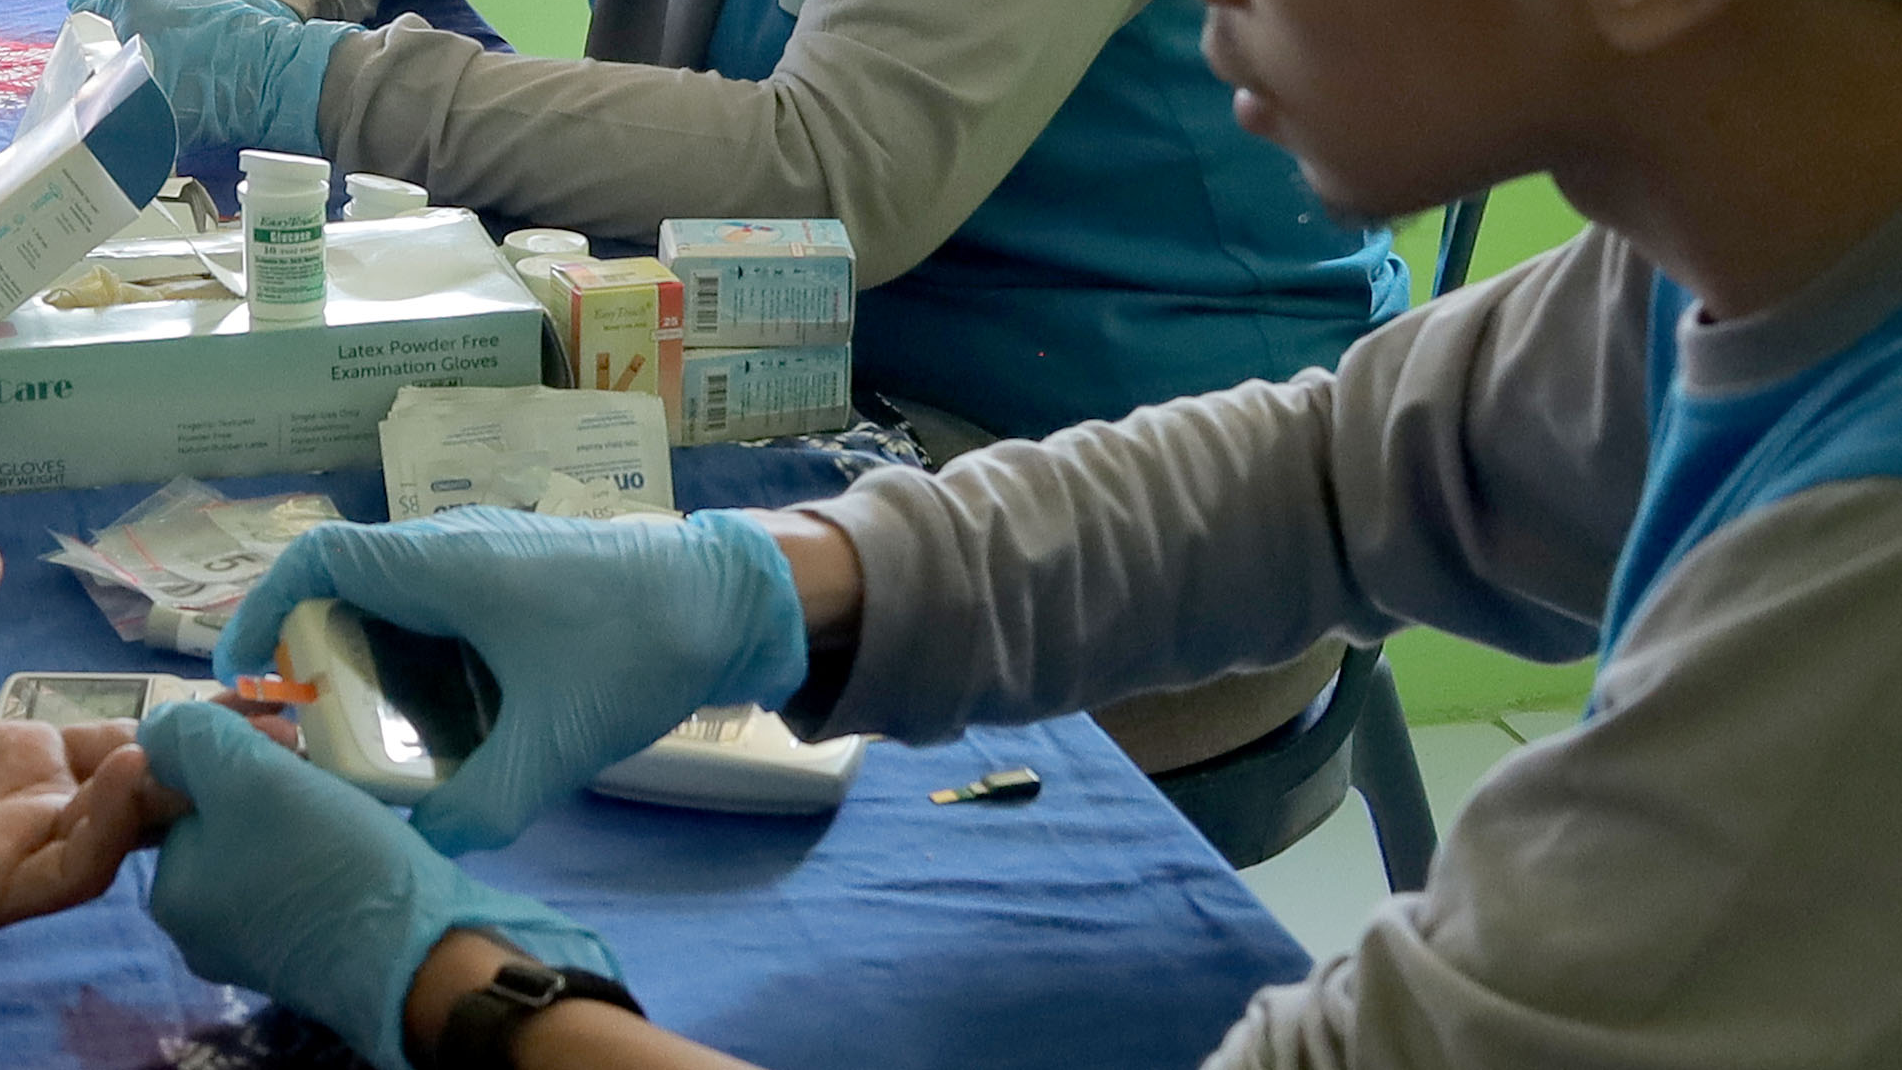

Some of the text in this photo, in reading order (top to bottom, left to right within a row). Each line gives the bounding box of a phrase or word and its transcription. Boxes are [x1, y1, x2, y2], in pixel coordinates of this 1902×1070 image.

[270, 231, 312, 243] Glucose
[338, 334, 500, 360] Latex Powder Free
[330, 353, 499, 381] Examination Gloves
[0, 459, 65, 476] GLOVES
[17, 473, 65, 485] WEIGHT
